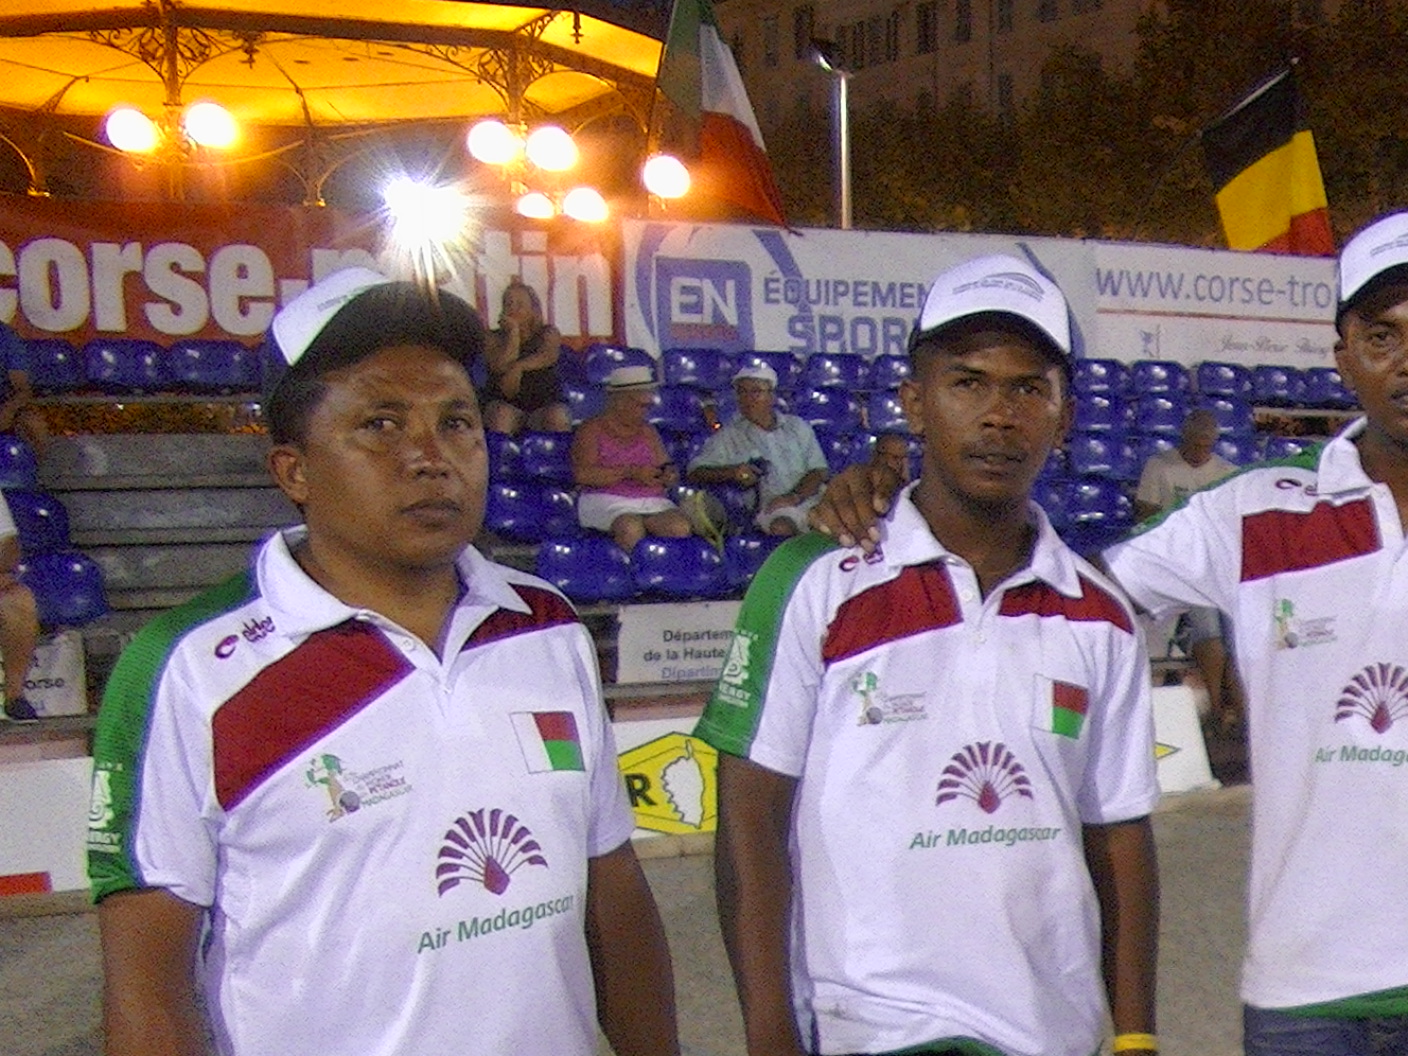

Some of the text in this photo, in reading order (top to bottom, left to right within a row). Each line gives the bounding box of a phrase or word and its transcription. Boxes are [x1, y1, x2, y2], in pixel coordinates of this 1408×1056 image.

[670, 277, 738, 326] EN
[1096, 267, 1332, 309] www.corse-tro
[788, 314, 918, 355] SPOR
[643, 651, 661, 662] de
[666, 649, 678, 660] la
[1314, 746, 1337, 763] Air
[909, 825, 1061, 850] Air Madagascar
[417, 927, 452, 954] Air
